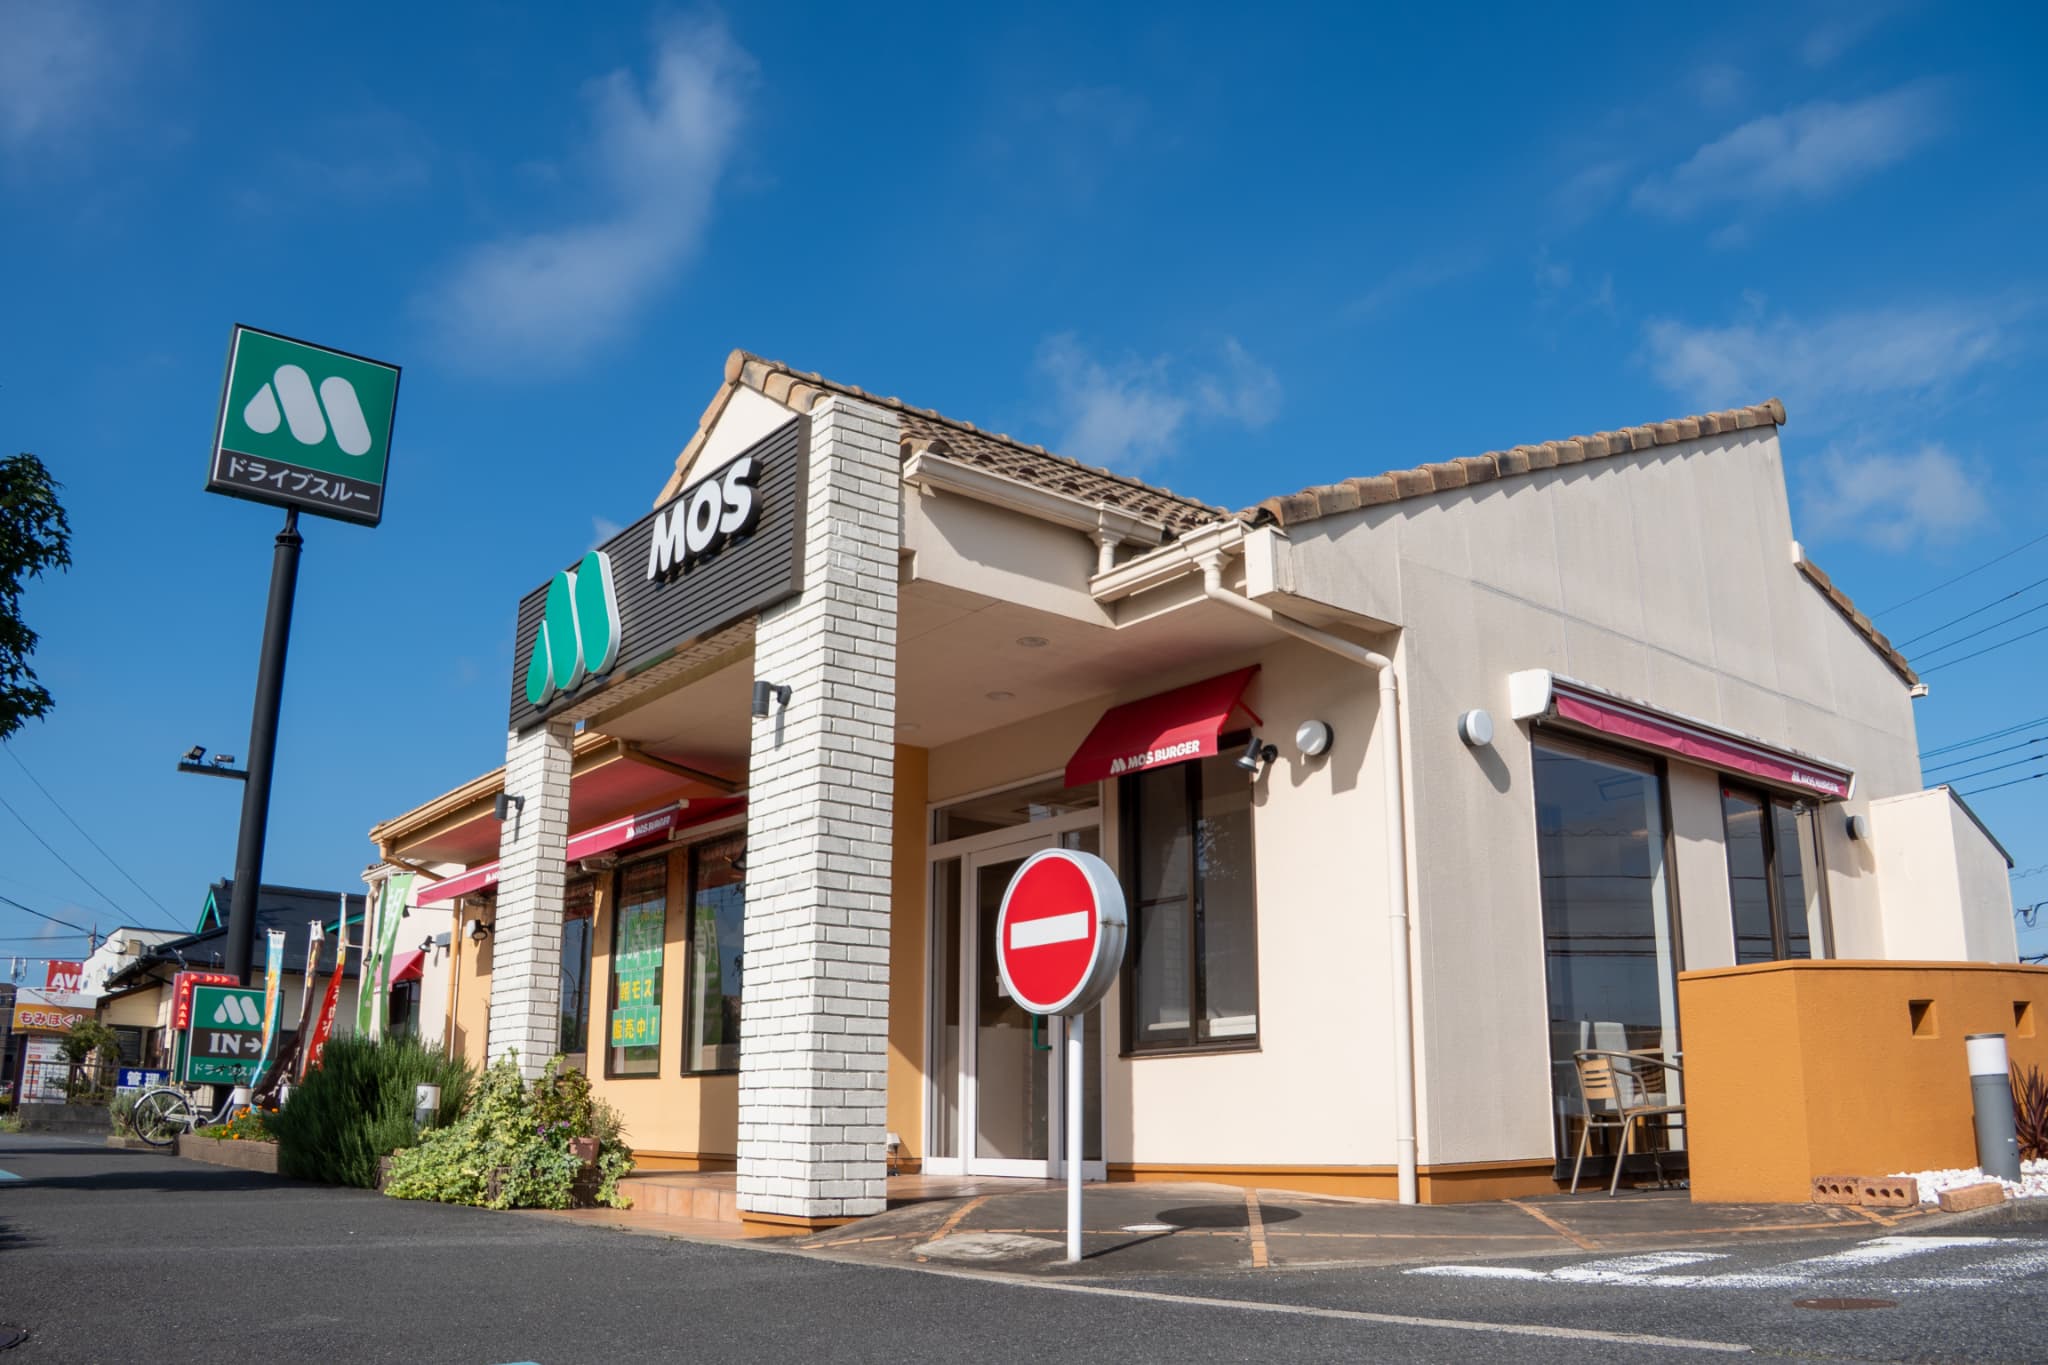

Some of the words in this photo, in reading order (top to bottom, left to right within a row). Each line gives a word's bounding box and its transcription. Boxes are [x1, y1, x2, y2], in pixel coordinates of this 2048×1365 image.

[228, 456, 371, 501] ドライブスルー
[647, 456, 753, 581] MOS
[1127, 751, 1154, 770] MOS
[1154, 739, 1200, 763] BURGER
[209, 1032, 243, 1055] IN
